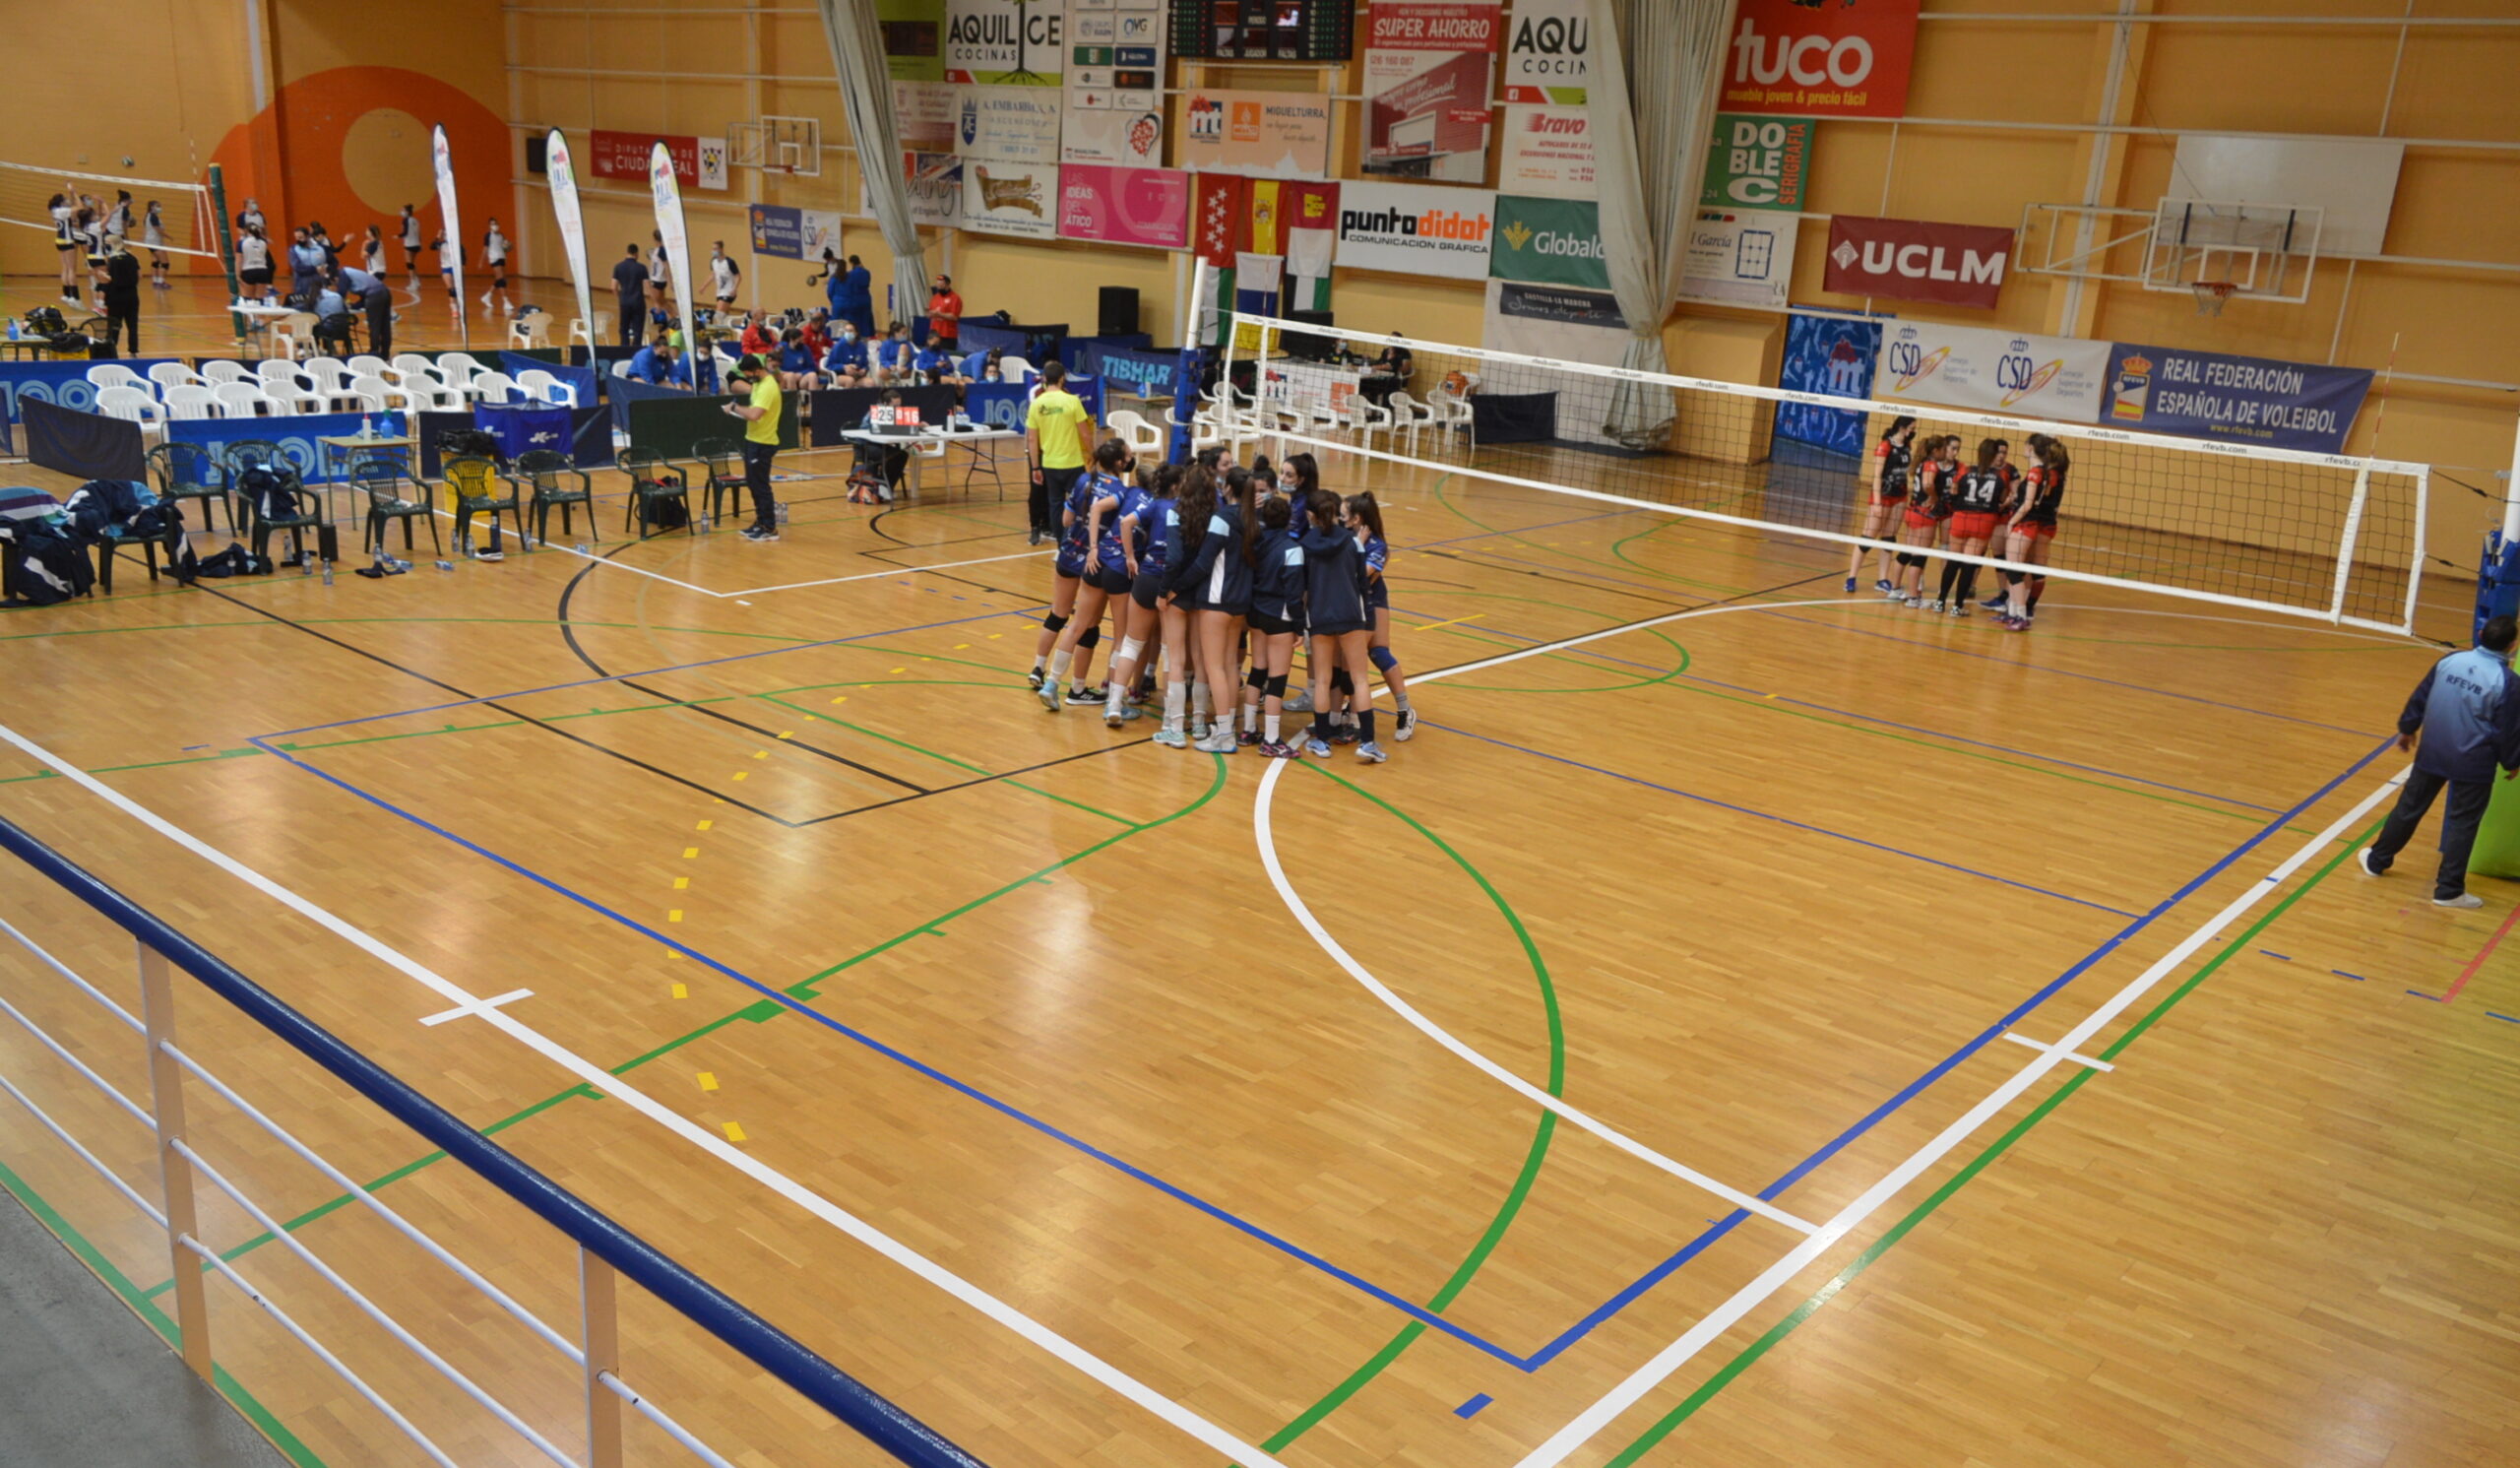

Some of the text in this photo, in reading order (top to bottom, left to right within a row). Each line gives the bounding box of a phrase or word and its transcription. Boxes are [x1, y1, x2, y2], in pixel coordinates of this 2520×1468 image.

[1374, 18, 1489, 39] SUPER AHORRO
[955, 48, 1016, 61] COCINAS
[1732, 18, 1873, 88] tuco
[1726, 89, 1867, 107] mueble joven & precio fácil
[1525, 113, 1586, 135] Bravo
[1732, 121, 1786, 150] DO
[681, 149, 695, 160] DE
[1729, 148, 1782, 177] BLE
[1066, 186, 1094, 200] IDEAS
[1728, 177, 1779, 204] C
[1064, 212, 1093, 227] ÁTICO
[1698, 232, 1732, 248] García
[1861, 240, 2007, 286] UCLM
[1890, 342, 1921, 376] CSD
[1102, 354, 1173, 386] TIBHAR
[1996, 354, 2033, 391] CSD
[2162, 357, 2304, 395] REAL FEDERACIÓN
[878, 409, 894, 422] 25
[904, 410, 919, 425] 16
[1879, 403, 1917, 415] rfevb.com
[2156, 390, 2338, 434] ESPAÑOLA DE VOLEIBOL
[1980, 415, 2020, 427] rfevb.com
[2209, 423, 2274, 439] www.rfevb.com
[2087, 428, 2130, 441] rfevb.com
[2201, 442, 2248, 455] rfevb.com
[1963, 478, 1996, 503] 14
[2446, 673, 2484, 695] RFEVB
